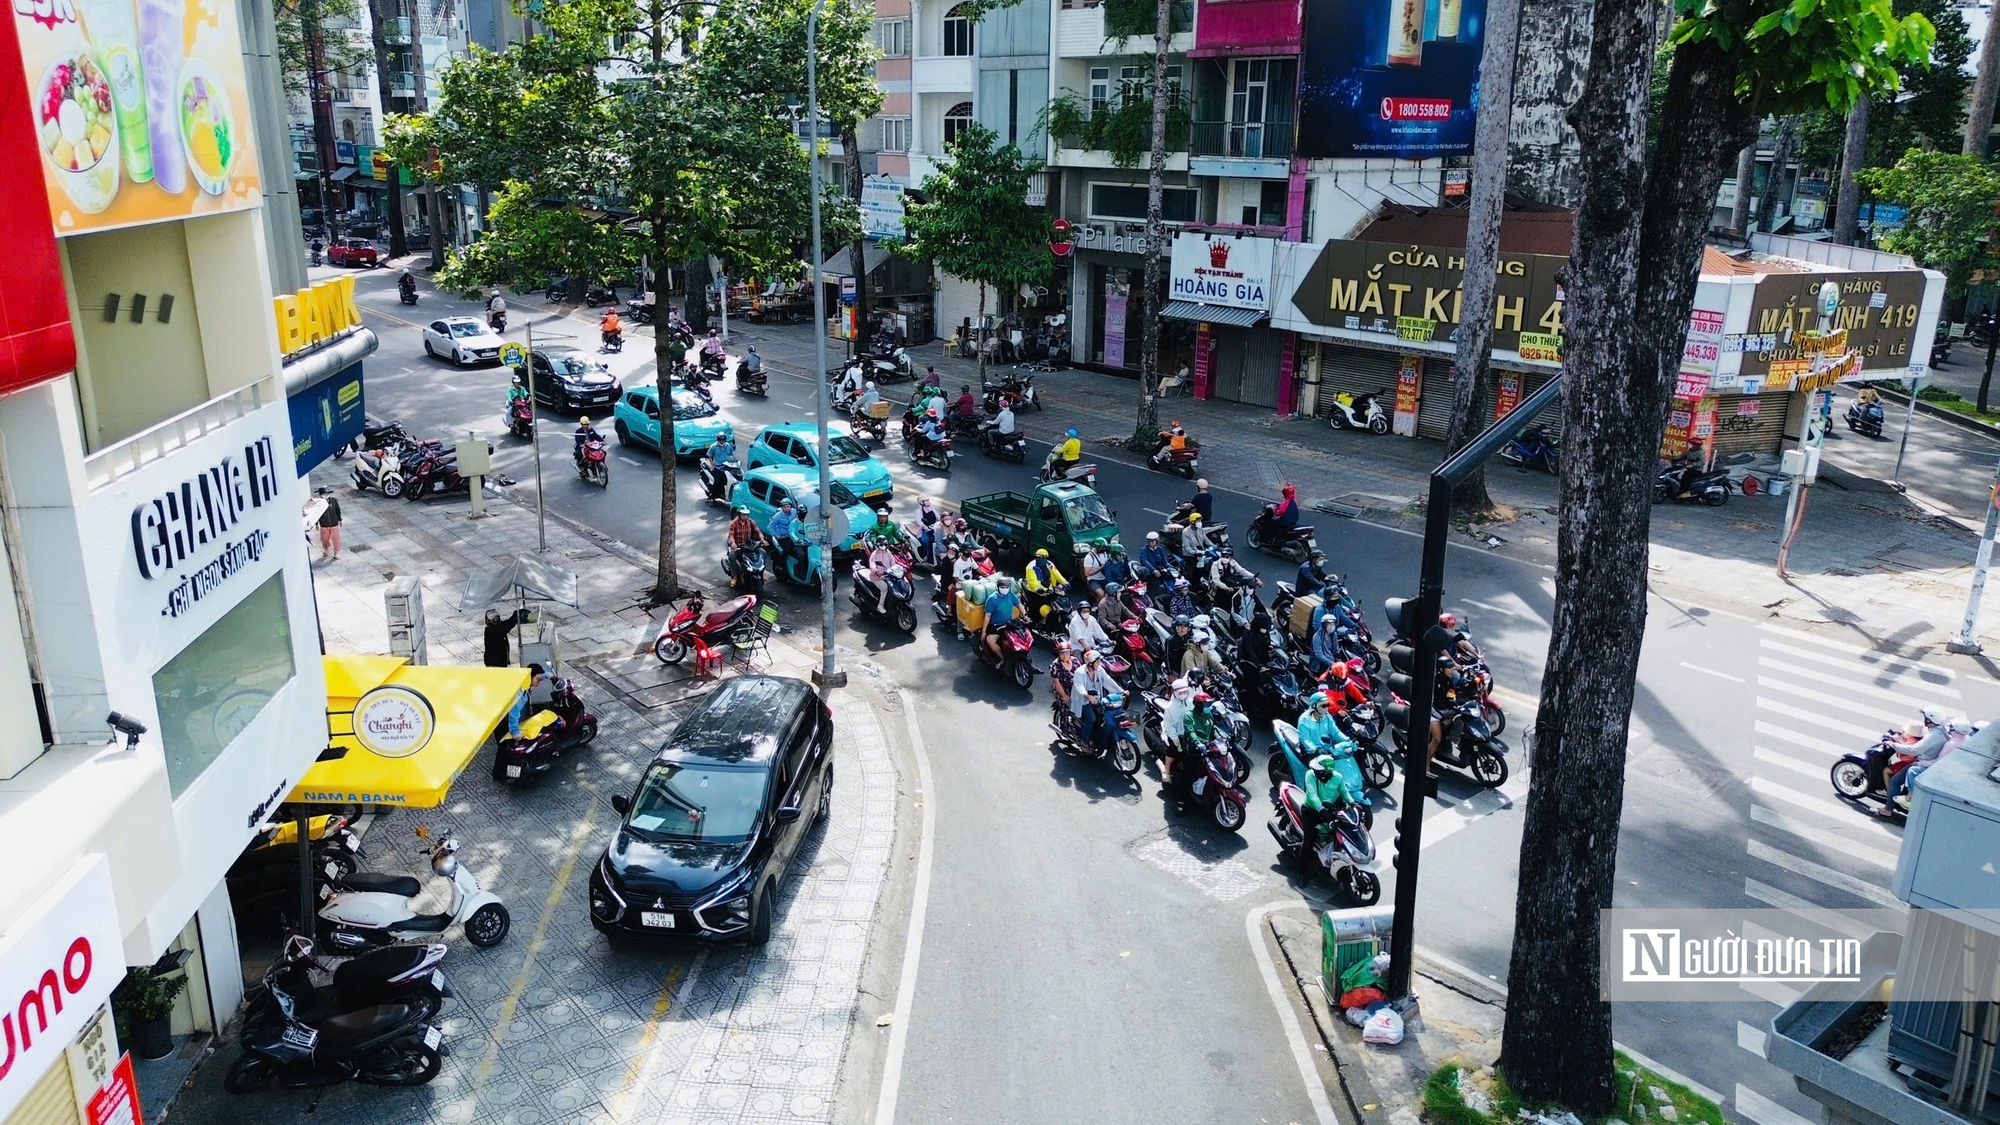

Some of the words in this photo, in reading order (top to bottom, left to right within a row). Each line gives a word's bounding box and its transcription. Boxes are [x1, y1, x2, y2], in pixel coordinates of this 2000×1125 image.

[1399, 103, 1418, 116] 1800
[1419, 104, 1433, 116] 558
[1434, 104, 1449, 117] 802
[1084, 228, 1147, 255] Pilate
[1388, 244, 1439, 269] CỬA
[1448, 256, 1525, 276] HG
[1222, 270, 1244, 279] THÀNH
[1174, 275, 1228, 297] HOÀNG
[1236, 284, 1264, 302] GIA
[1841, 277, 1882, 294] HÀNG
[1329, 263, 1411, 317] MẮT
[1424, 279, 1525, 332] KÍH
[1539, 300, 1562, 336] 4
[273, 273, 362, 355] BANK
[1759, 295, 1812, 333] MẮT
[1816, 300, 1870, 330] ÍNH
[1879, 304, 1918, 330] 419
[1397, 326, 1410, 339] 0972
[1412, 328, 1422, 340] 377
[1521, 335, 1537, 345] CHO
[1540, 336, 1561, 347] THUÊ
[1520, 347, 1541, 360] 0926
[1889, 337, 1906, 356] LẺ
[131, 455, 246, 580] CHANG
[245, 435, 279, 508] HI
[368, 719, 412, 734] Changhi
[304, 792, 343, 801] NAM
[347, 793, 357, 802] A
[361, 794, 406, 803] BANK
